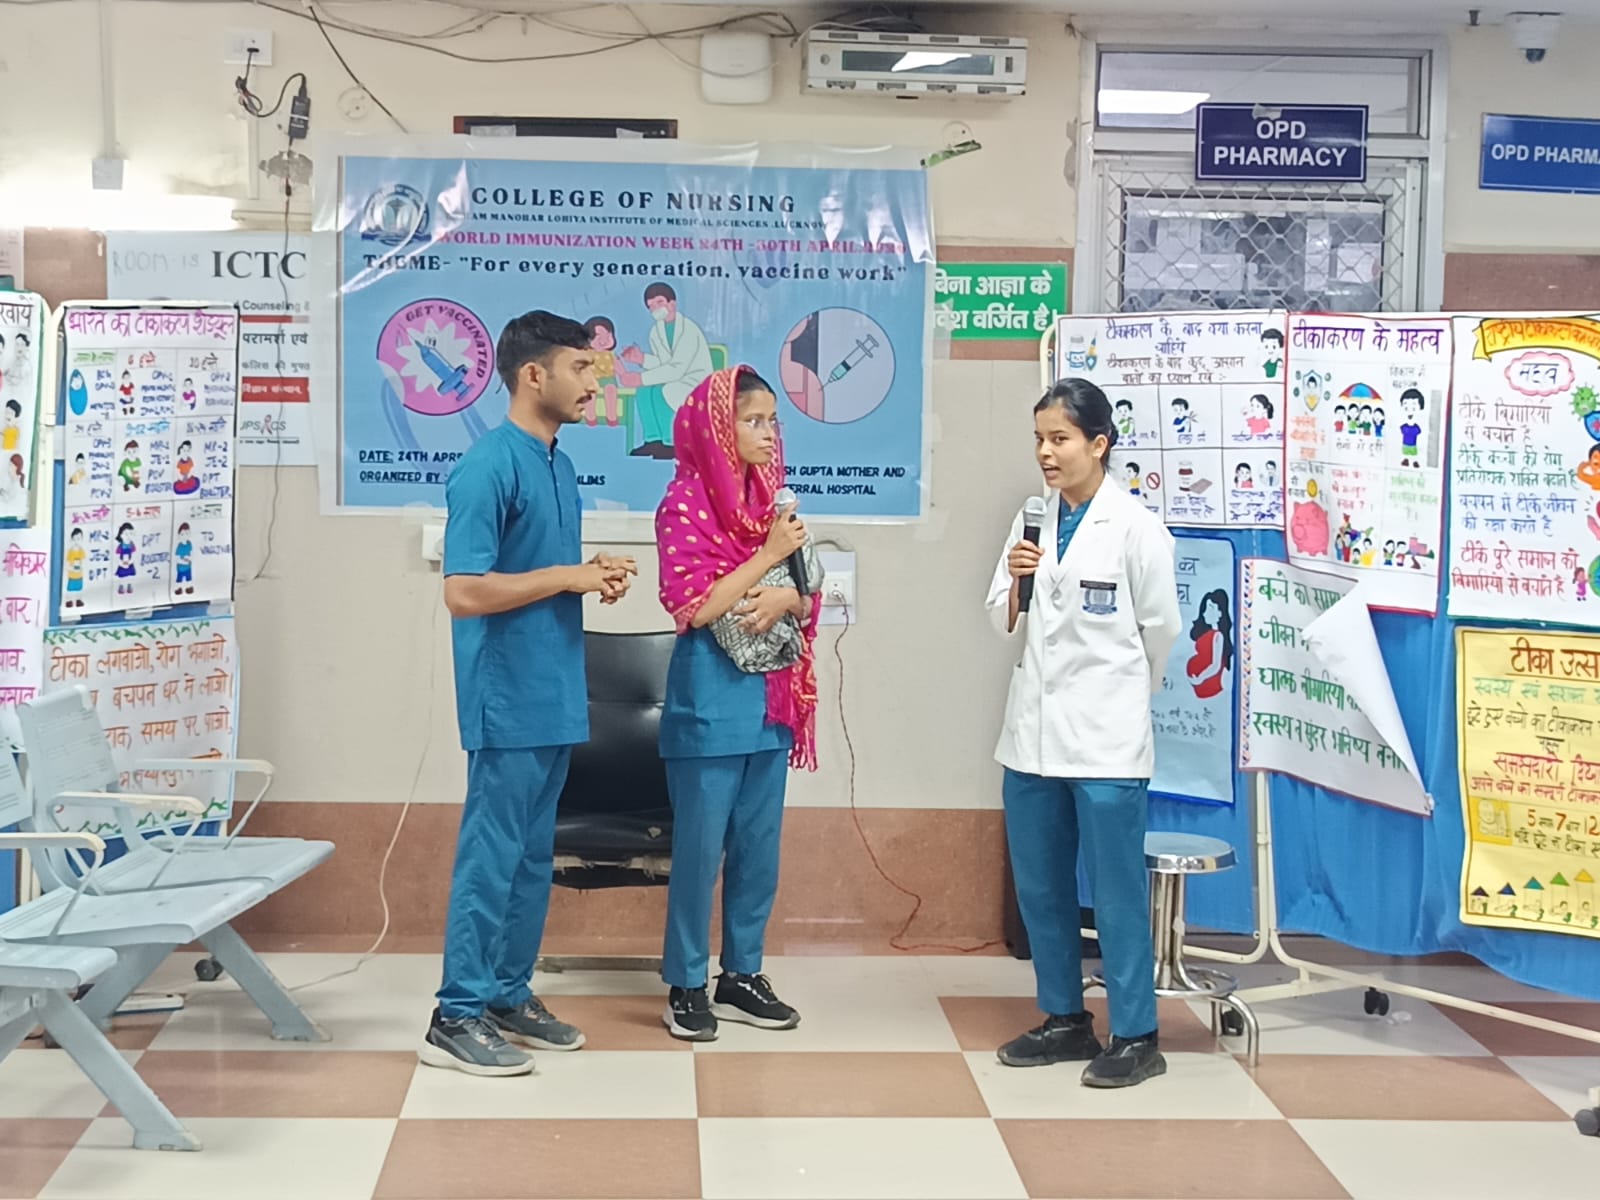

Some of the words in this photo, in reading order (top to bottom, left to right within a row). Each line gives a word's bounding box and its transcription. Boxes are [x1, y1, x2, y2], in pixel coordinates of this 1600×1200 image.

[1256, 119, 1306, 140] OPD
[1213, 146, 1348, 167] PHARMACY
[1491, 143, 1529, 162] OPD
[471, 187, 605, 208] COLLEGE
[617, 190, 654, 210] OF
[667, 192, 796, 213] NURSING
[490, 213, 544, 222] MANOHAR
[547, 214, 586, 223] LOHIYA
[589, 215, 646, 225] INSTITUTE
[649, 216, 663, 225] OF
[506, 232, 636, 248] IMMUNIZATION
[642, 236, 694, 250] WEEK
[212, 250, 307, 279] ICTC
[519, 257, 584, 278] every
[739, 262, 830, 281] vaccine
[1029, 269, 1053, 295] के
[405, 304, 435, 322] GET
[438, 304, 488, 379] VACCINATED
[1293, 318, 1365, 351] टीकाकरण
[1372, 321, 1391, 352] के
[1397, 328, 1444, 355] महत्व
[397, 450, 429, 463] 24TH
[359, 470, 422, 483] ORGANIZED
[426, 471, 441, 483] BY
[799, 465, 834, 477] GUPTA
[836, 466, 880, 478] MOTHER
[883, 466, 906, 478] AND
[826, 484, 877, 496] HOSPITAL
[50, 646, 90, 682] टीका
[1509, 636, 1555, 675] टीका
[1560, 648, 1600, 679] उत्स
[1527, 808, 1537, 827] 5
[1555, 812, 1568, 832] 7
